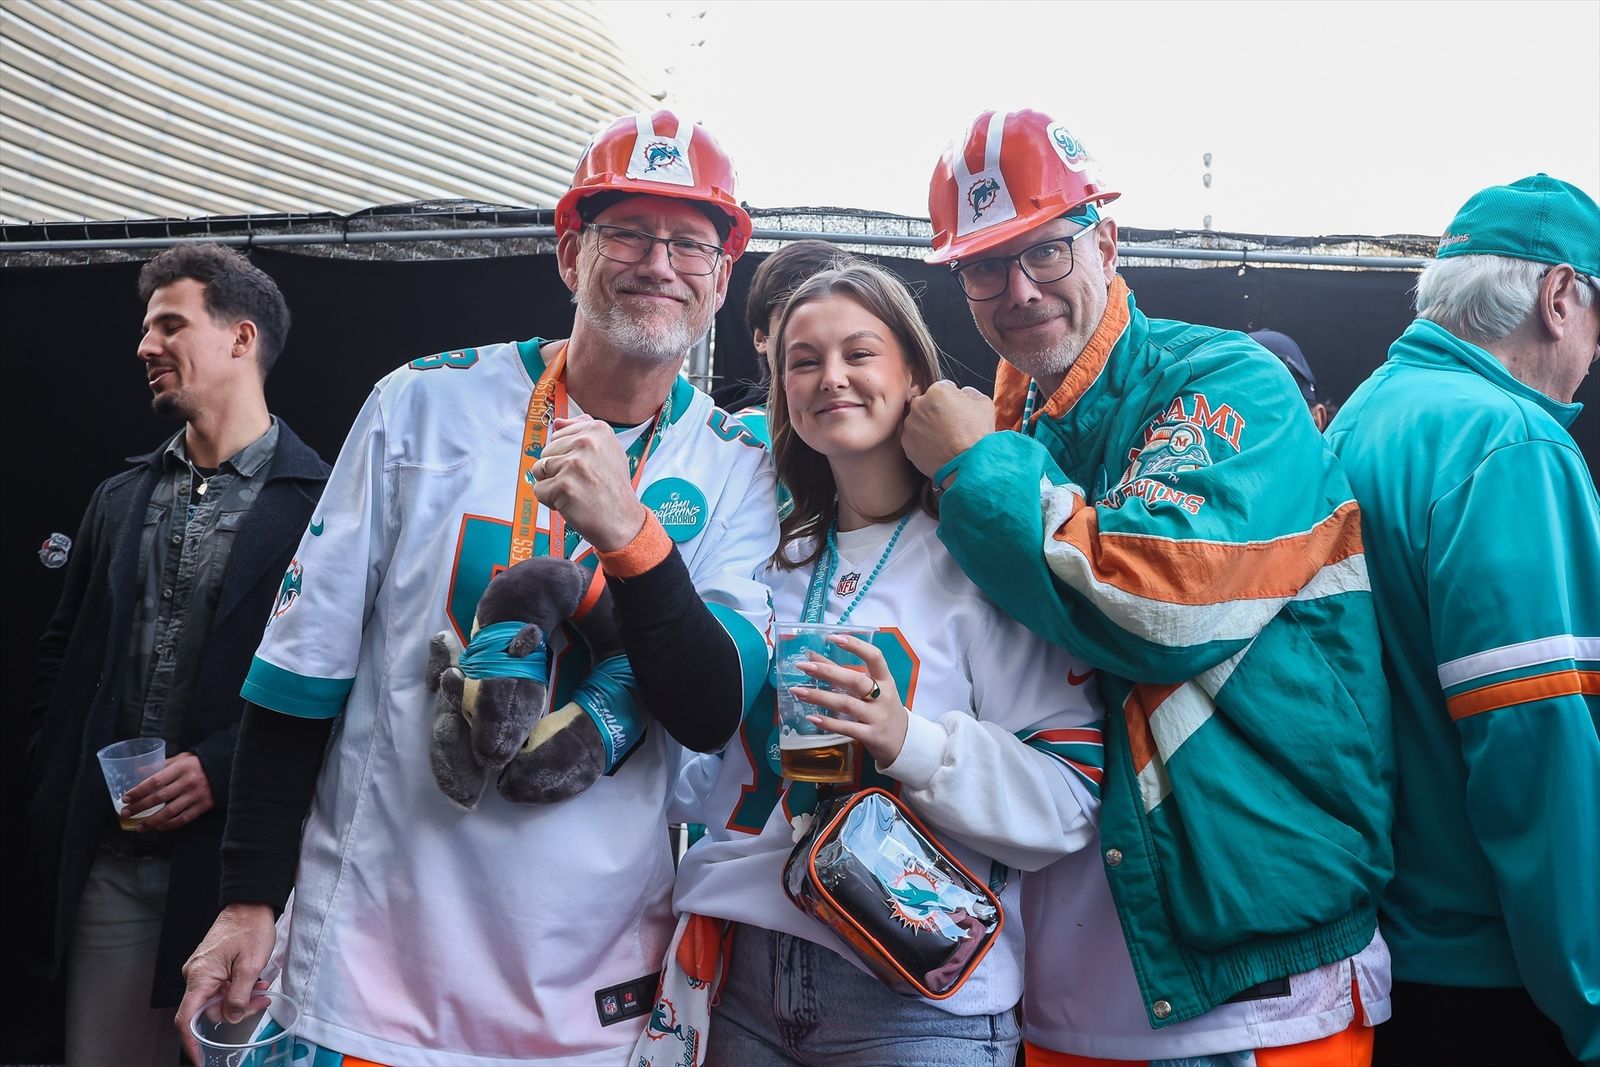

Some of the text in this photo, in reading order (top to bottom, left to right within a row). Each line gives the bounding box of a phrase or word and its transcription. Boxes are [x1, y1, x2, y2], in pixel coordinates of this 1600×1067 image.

[1175, 437, 1189, 447] M
[660, 500, 690, 510] MIAMI
[665, 515, 696, 525] MADRID
[838, 581, 855, 593] NFL
[807, 586, 823, 622] Dolphins
